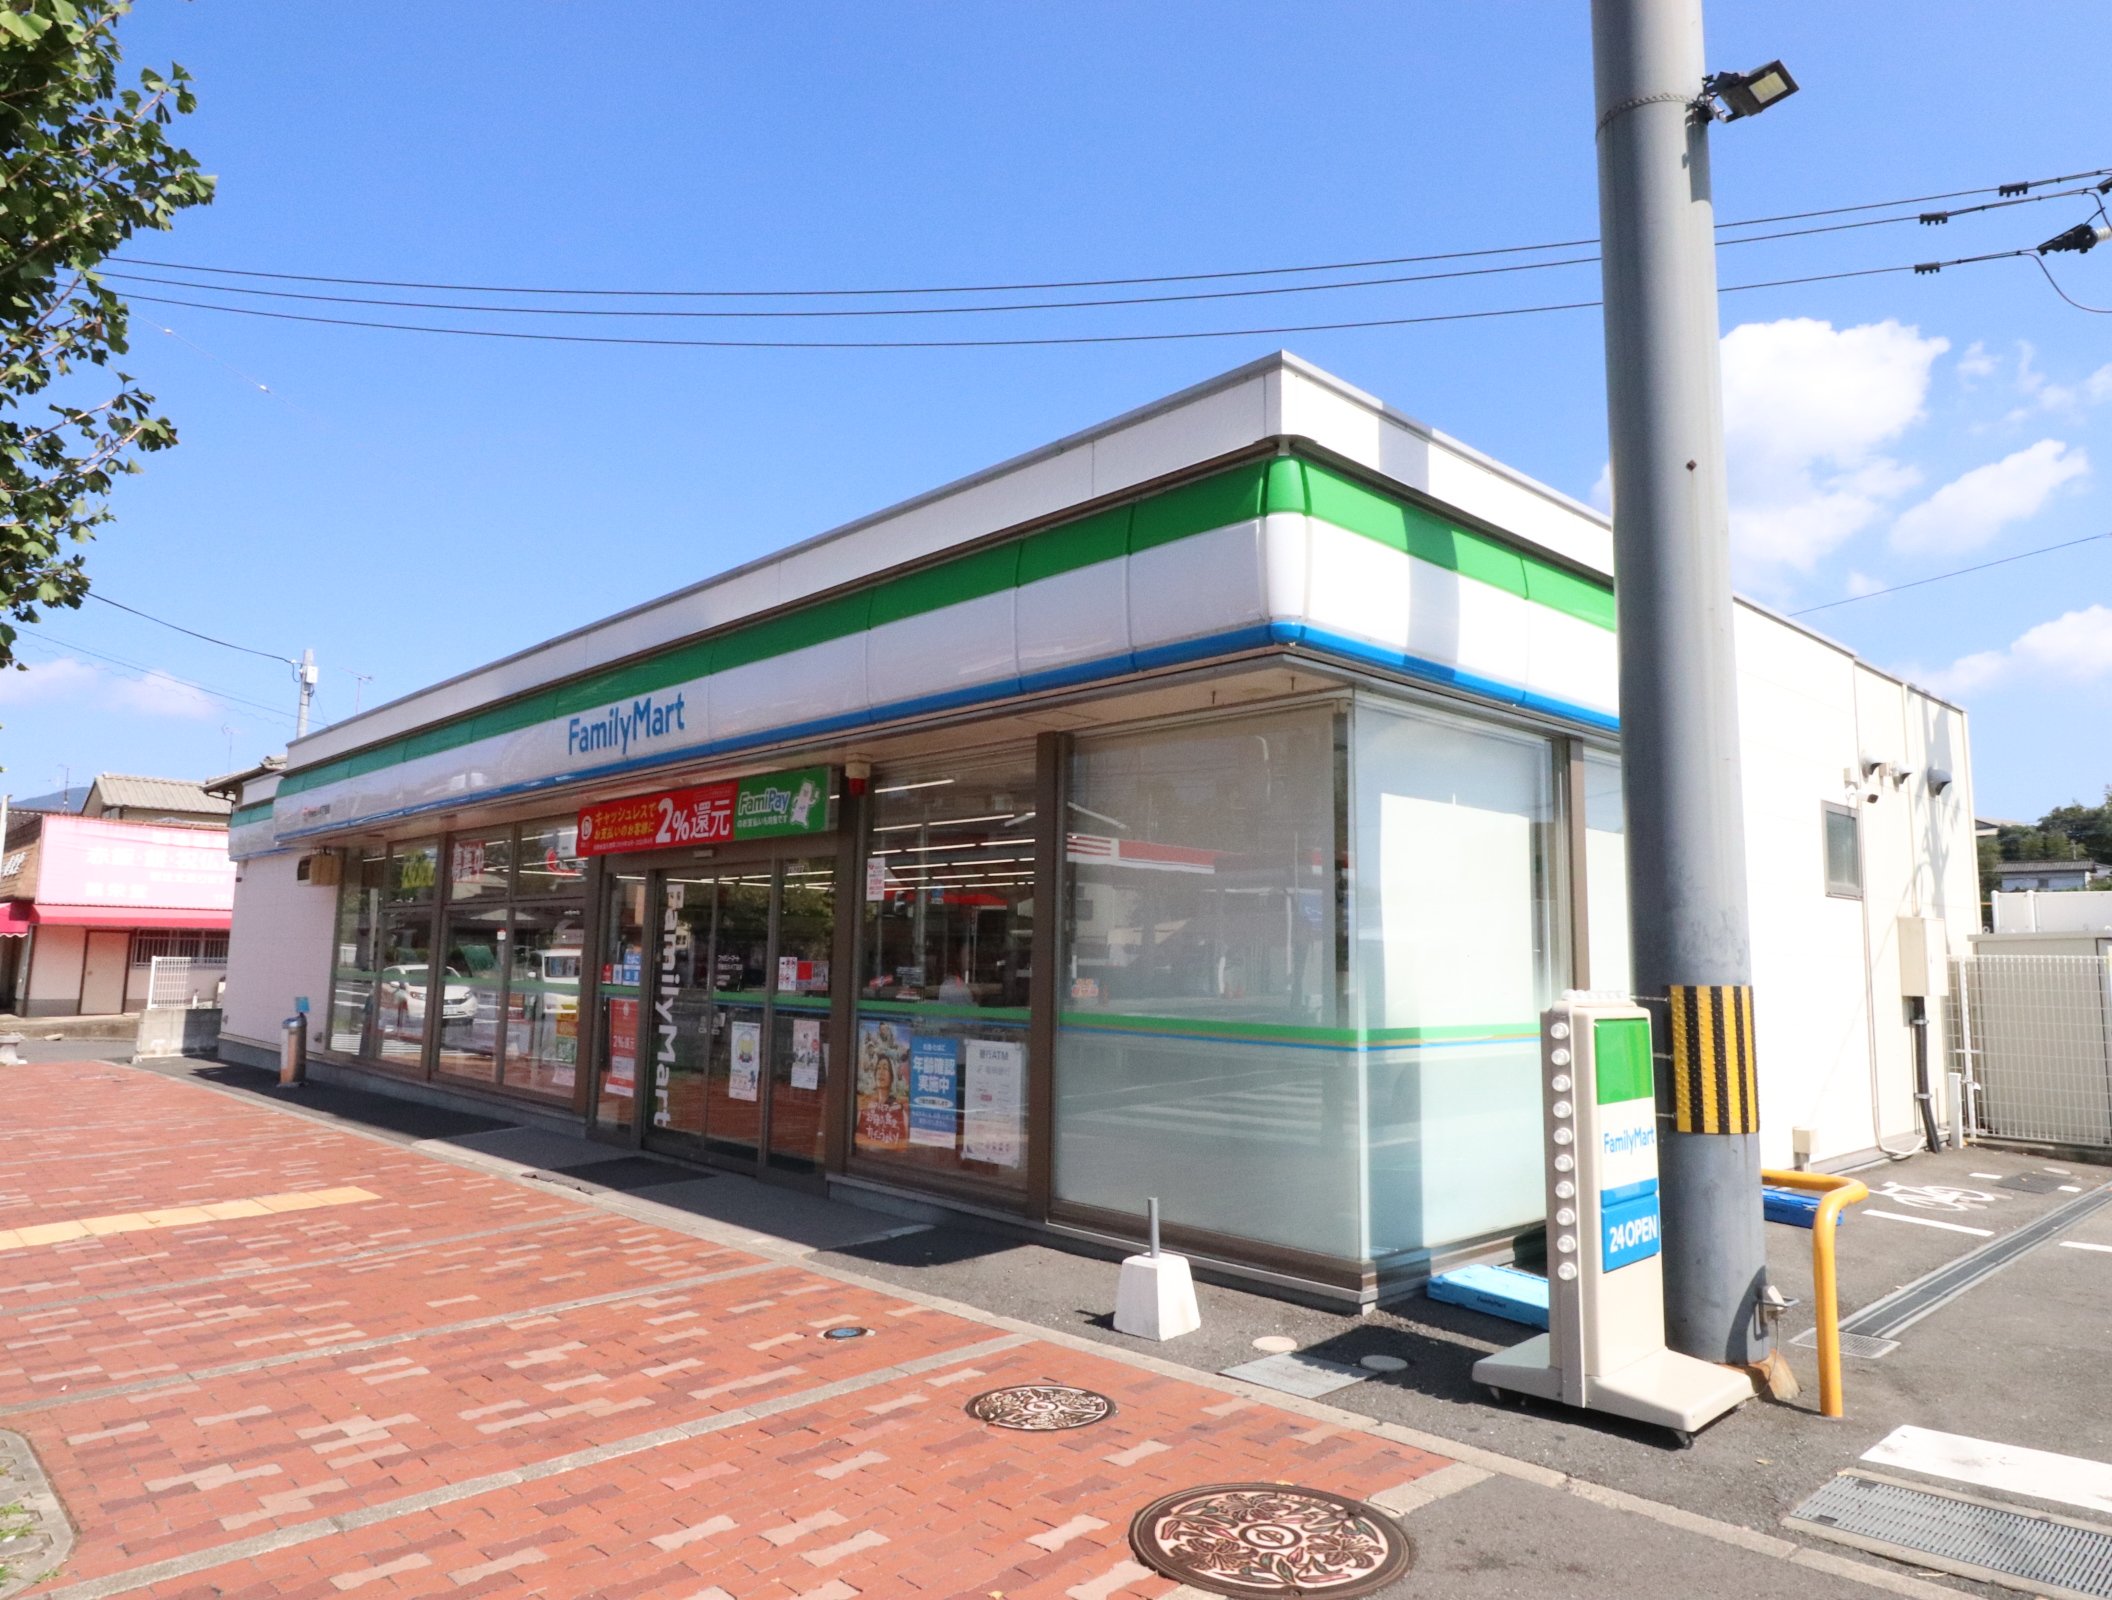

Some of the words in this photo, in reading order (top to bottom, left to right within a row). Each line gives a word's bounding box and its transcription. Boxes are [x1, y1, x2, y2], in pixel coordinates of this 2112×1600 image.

[568, 692, 685, 756] FamilyMart
[594, 802, 657, 827] キャッシュレスで
[737, 787, 791, 816] FamiPay
[655, 797, 731, 844] 2%還元
[653, 884, 685, 1128] FamilyMart
[912, 1056, 956, 1076] 年齢確認
[918, 1074, 950, 1094] 実施中
[1603, 1126, 1655, 1156] FamilyMart
